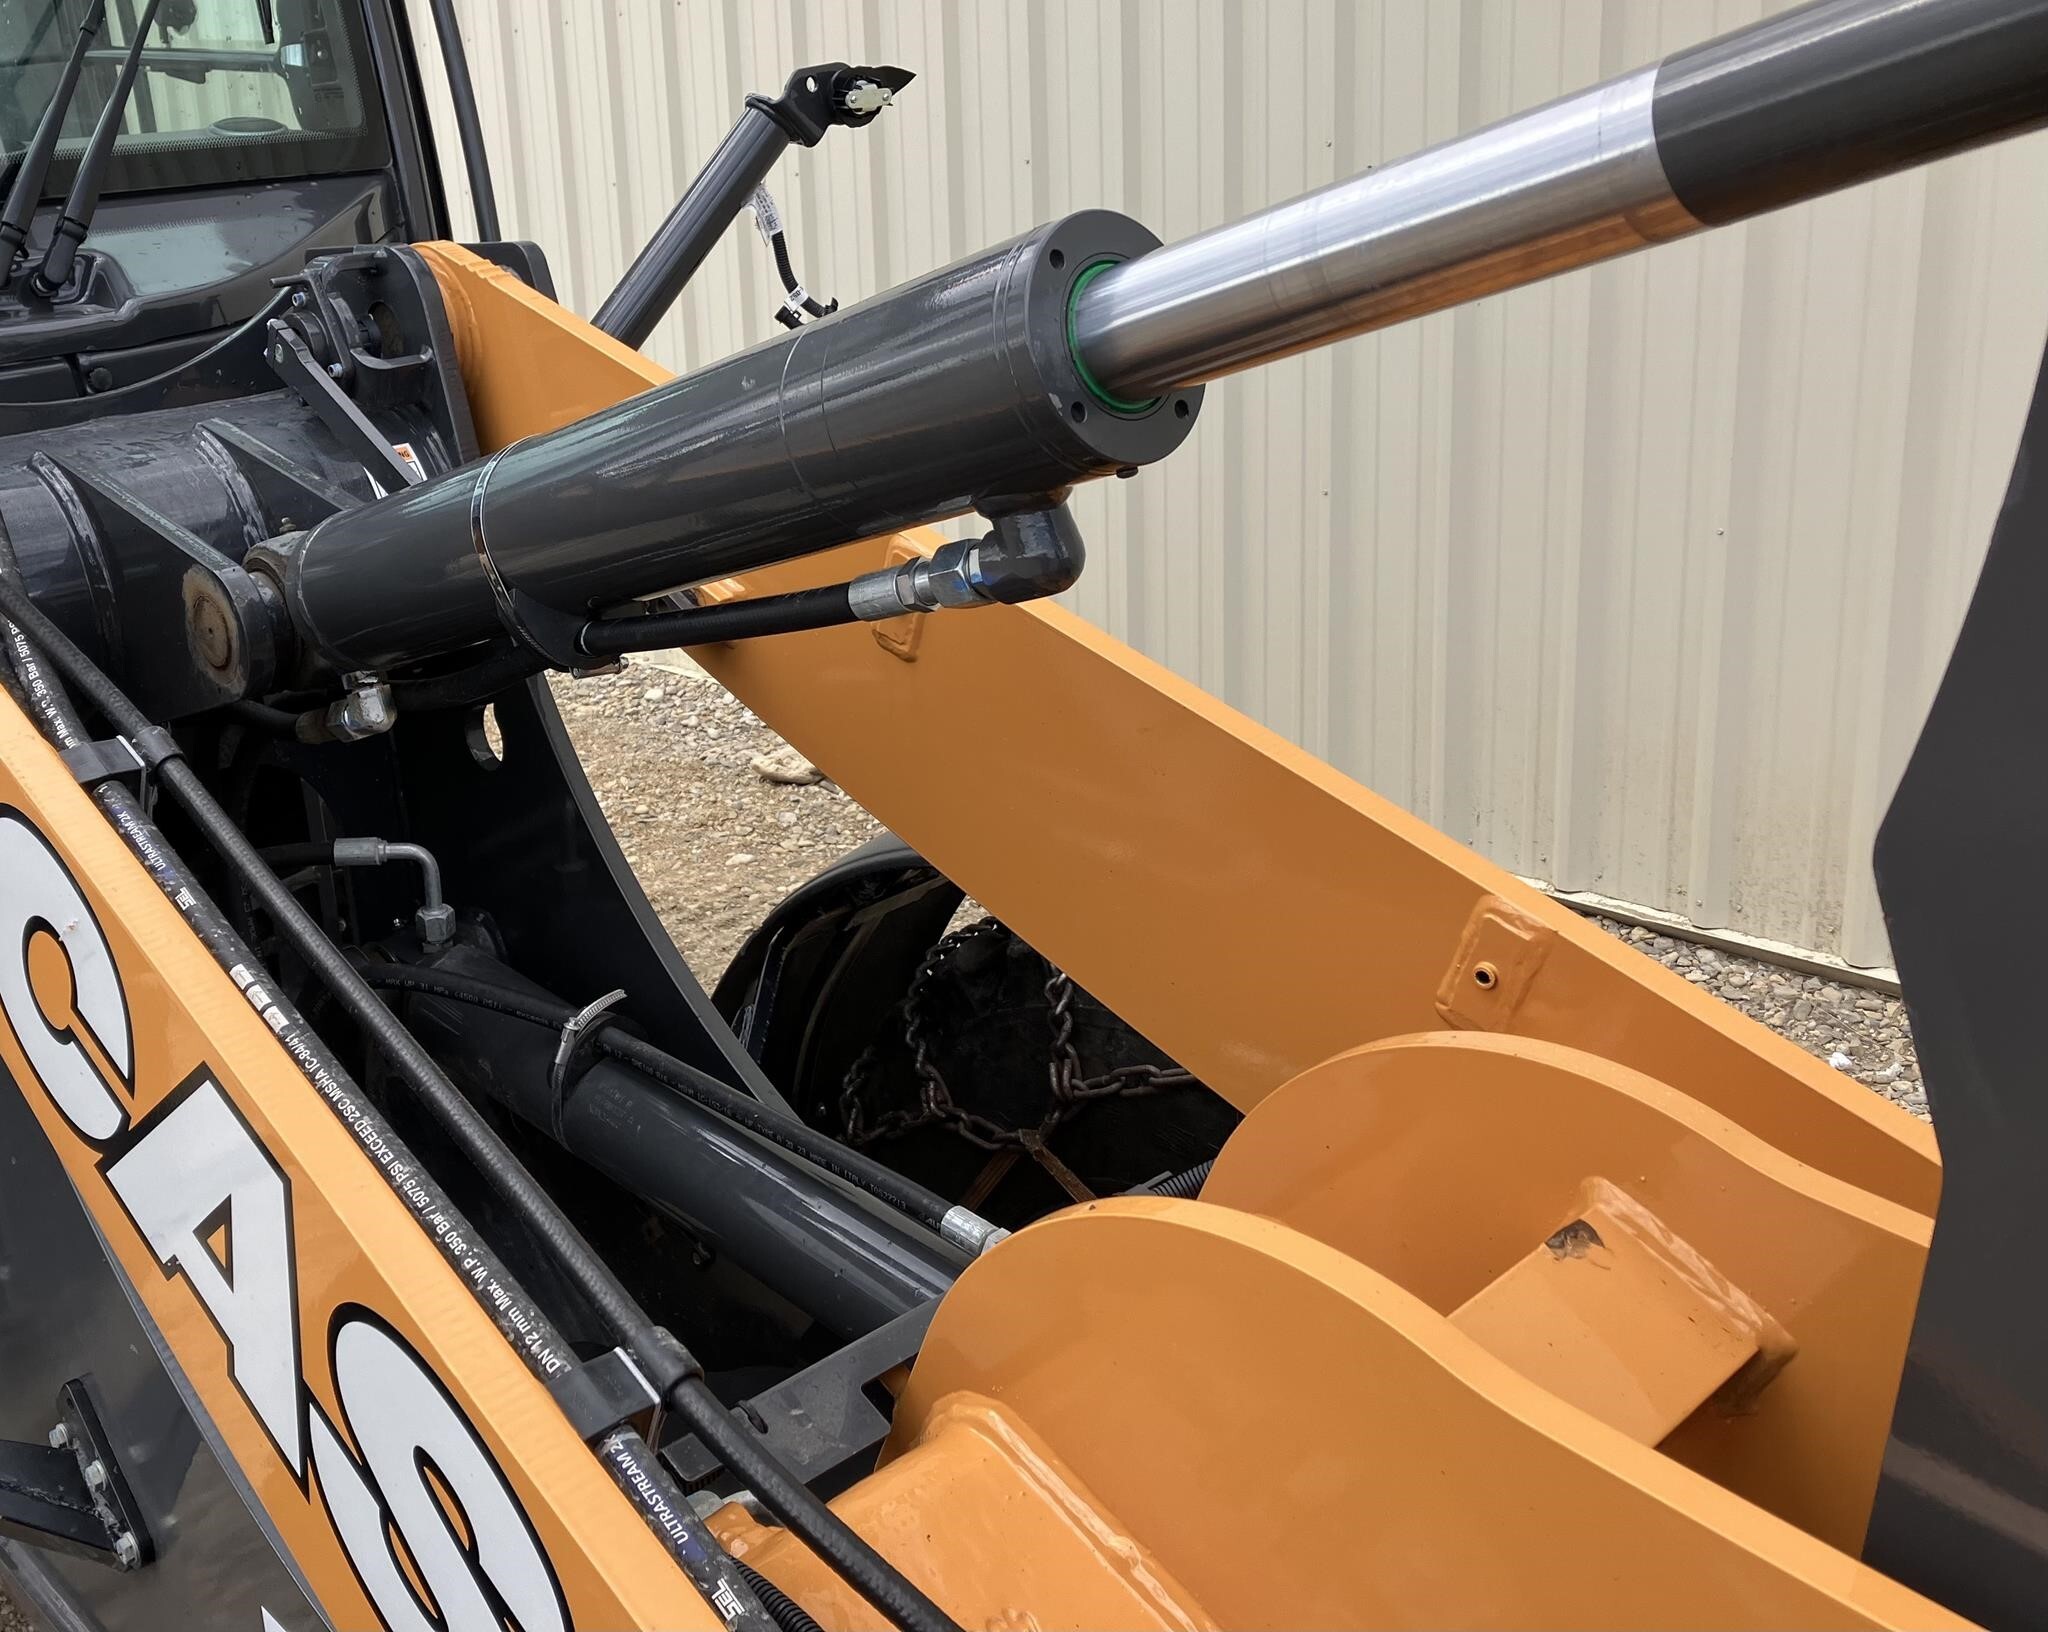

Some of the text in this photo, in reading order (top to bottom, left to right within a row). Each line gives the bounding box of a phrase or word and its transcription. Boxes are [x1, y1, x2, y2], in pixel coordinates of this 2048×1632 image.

[14, 634, 29, 657] 5075
[26, 663, 39, 680] Bar
[32, 679, 47, 697] 350
[117, 811, 131, 822] 2K
[125, 819, 166, 871] ULTRASTREAM
[419, 982, 429, 991] 31
[433, 986, 449, 995] MPa
[285, 1033, 320, 1072] IC-84/41
[315, 1068, 343, 1101] MSHA
[338, 1098, 360, 1122] 2SC
[354, 1120, 394, 1164] EXCEED
[387, 1160, 409, 1183] PSI
[844, 1169, 867, 1187] ITALY
[403, 1179, 429, 1208] 5075
[429, 1212, 450, 1235] Bar
[444, 1231, 467, 1255] 350
[464, 1252, 487, 1283] W.P.
[487, 1278, 512, 1311] Max.
[508, 1307, 531, 1333] mm
[525, 1332, 543, 1350] 12
[538, 1348, 560, 1374] DN
[604, 1434, 688, 1544] ULTRASTREAM 2K
[711, 1577, 745, 1621] SEL
